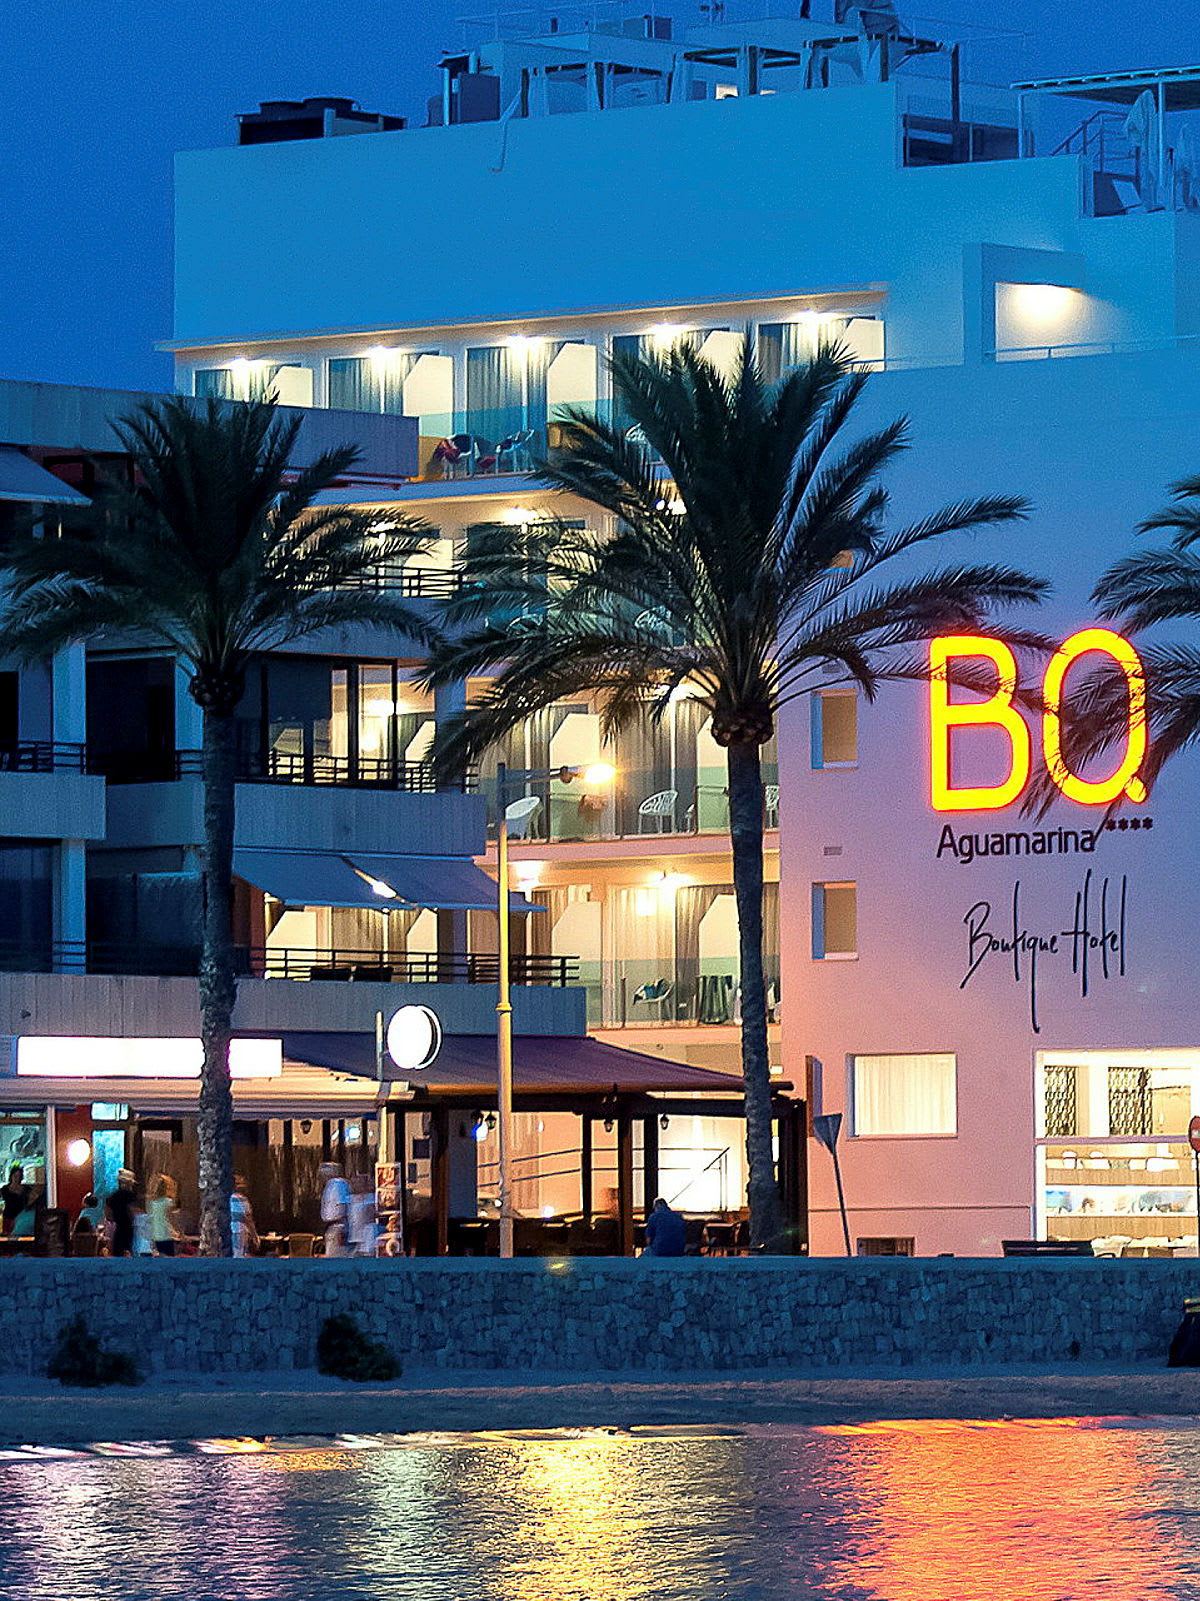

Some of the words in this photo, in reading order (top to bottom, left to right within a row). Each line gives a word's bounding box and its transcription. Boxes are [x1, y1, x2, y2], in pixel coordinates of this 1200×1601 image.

[929, 628, 1148, 812] BQ
[937, 825, 1096, 864] Aguamarina
[960, 879, 1059, 1034] Boutique
[1061, 868, 1128, 997] Hotel
